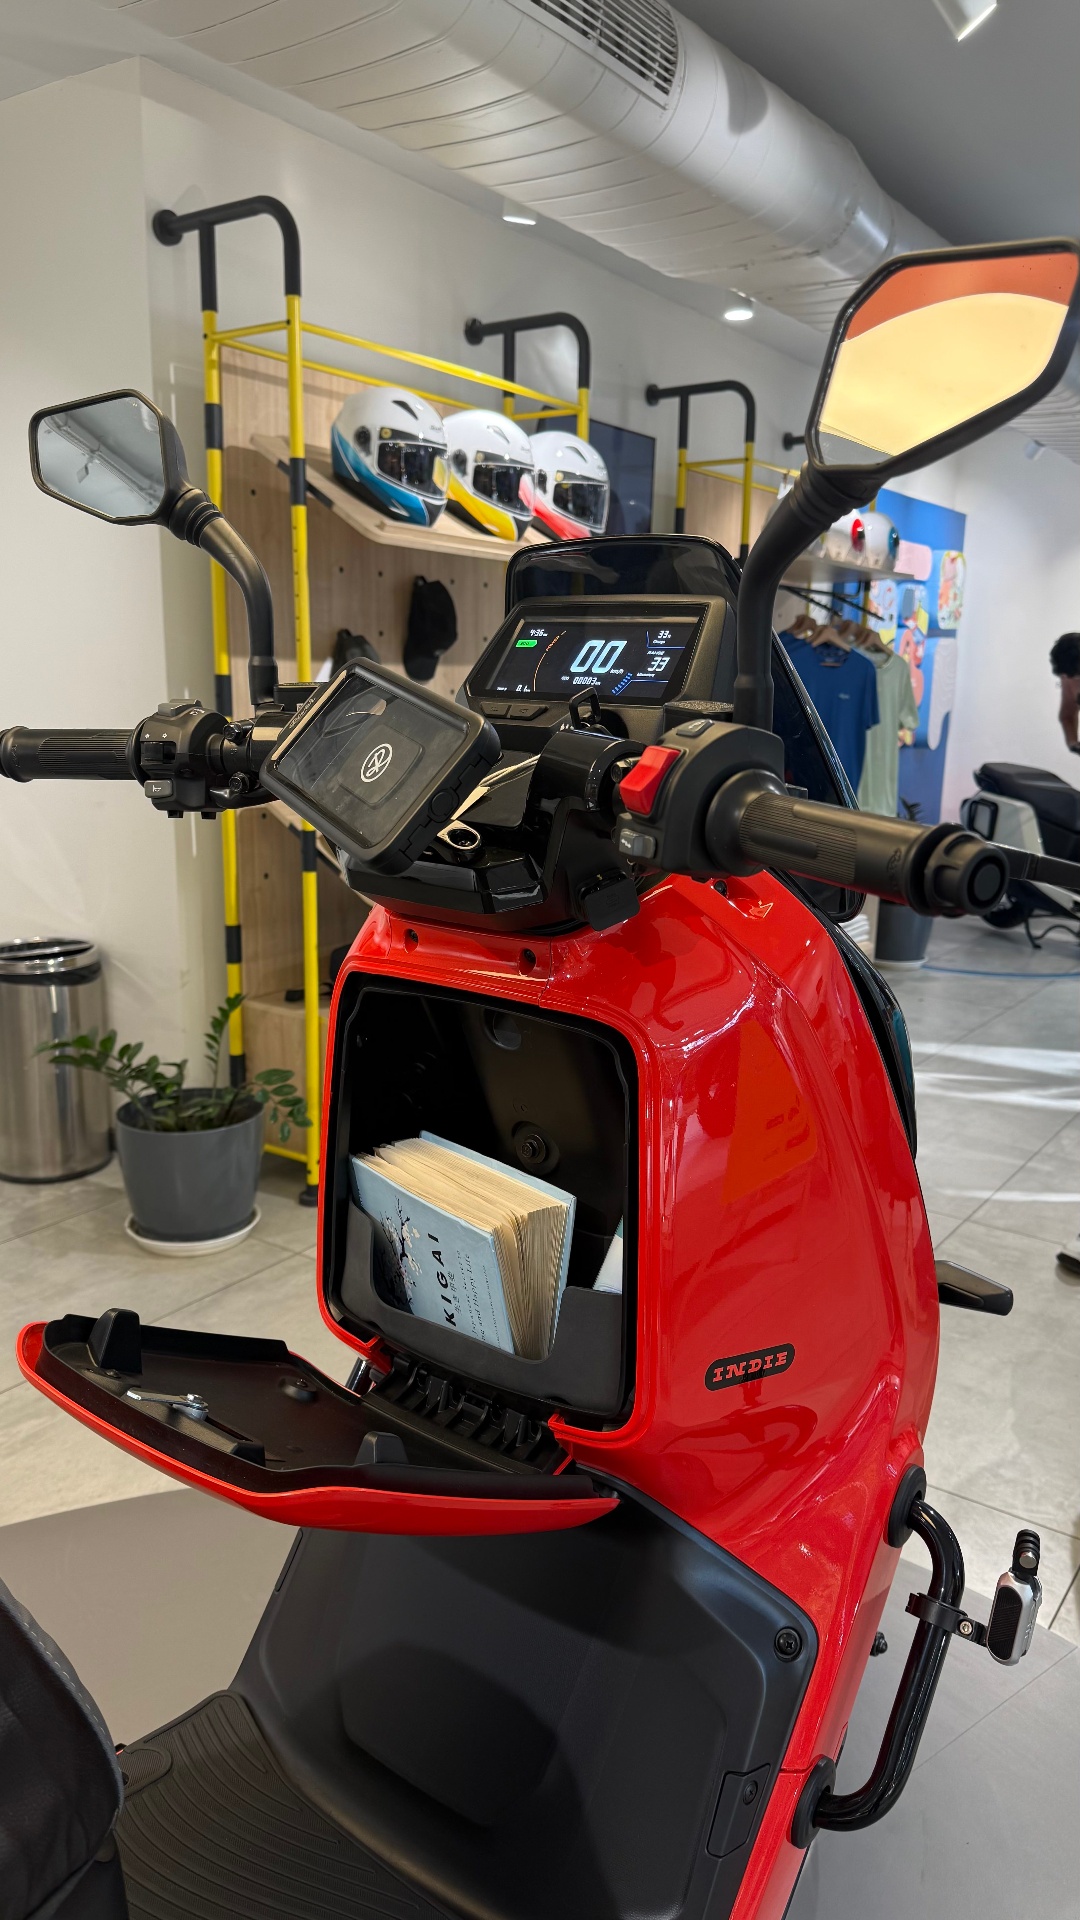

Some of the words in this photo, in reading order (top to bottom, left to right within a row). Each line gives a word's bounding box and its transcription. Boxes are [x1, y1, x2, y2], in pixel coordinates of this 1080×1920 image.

[570, 640, 627, 673] 00
[647, 657, 670, 672] 33
[465, 1253, 473, 1274] Life
[428, 1233, 457, 1327] KIGAI
[470, 1277, 479, 1308] Happy
[713, 1351, 787, 1382] INDIE
